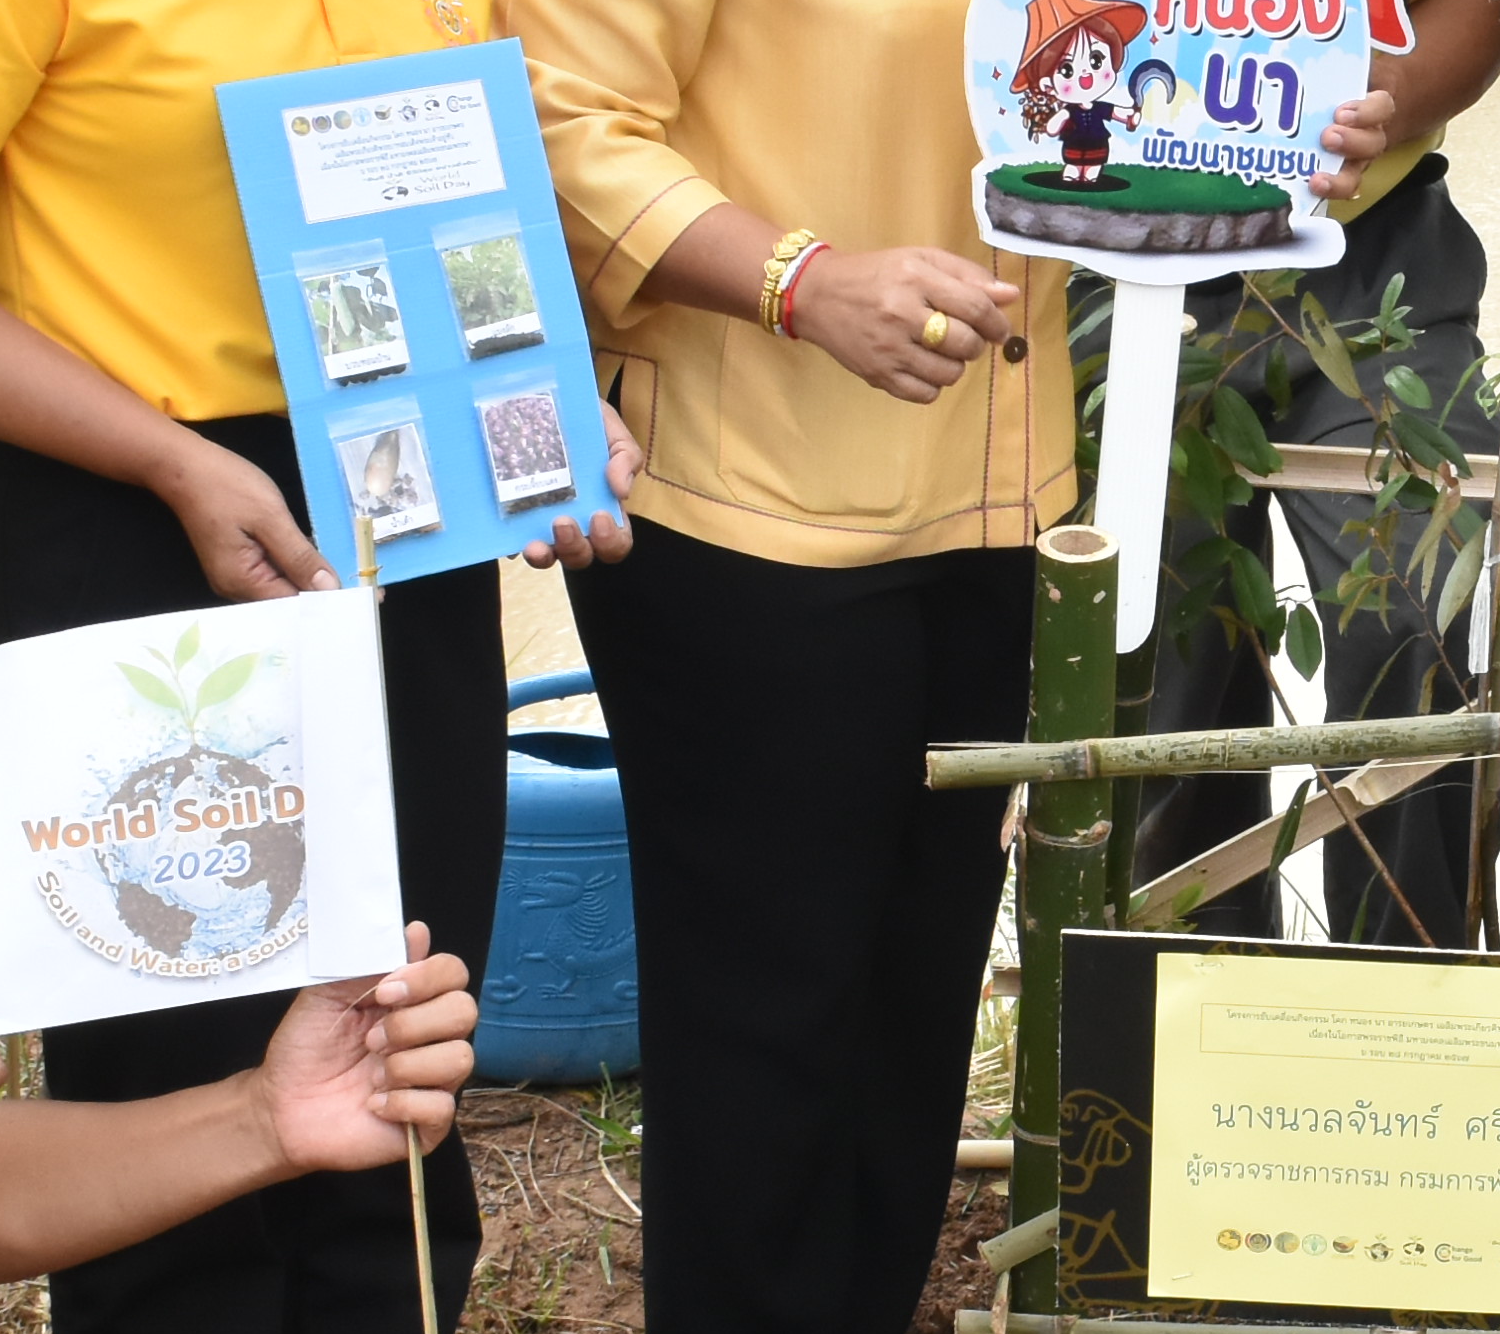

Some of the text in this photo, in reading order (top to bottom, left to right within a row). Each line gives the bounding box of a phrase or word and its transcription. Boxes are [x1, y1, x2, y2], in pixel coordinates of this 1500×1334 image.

[1203, 52, 1300, 133] นา
[1141, 127, 1320, 187] พัฒนาชุมชน
[21, 805, 156, 853] World
[173, 791, 255, 833] Soil
[153, 844, 252, 884] 2023
[36, 869, 76, 927] Soil
[76, 924, 123, 959] and
[130, 947, 220, 976] Water:
[226, 955, 241, 971] a
[1211, 1099, 1443, 1140] นางนวลจันทร์
[1186, 1152, 1389, 1187] ผู้ตรวจราชการกรม
